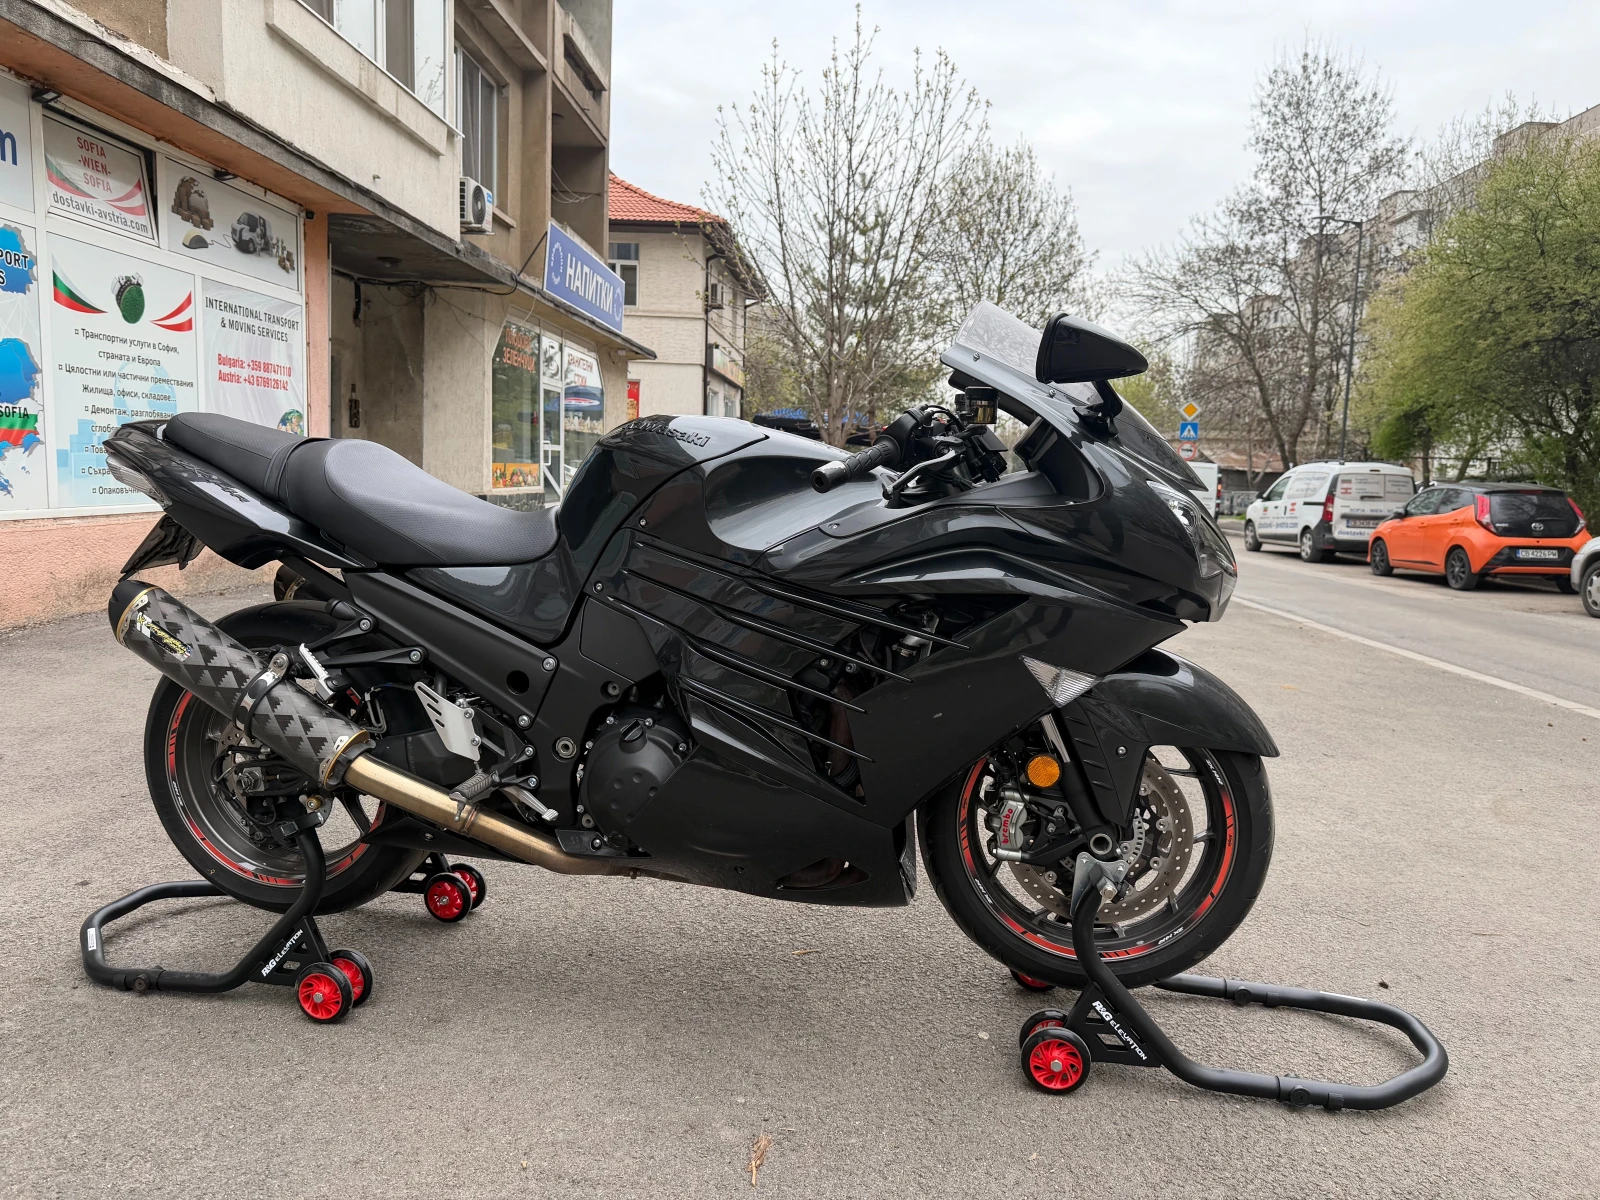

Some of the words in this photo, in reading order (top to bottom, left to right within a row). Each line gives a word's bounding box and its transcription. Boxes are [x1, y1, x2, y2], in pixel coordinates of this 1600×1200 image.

[77, 136, 107, 159] SOFIA
[78, 154, 112, 176] -WIEN-
[82, 172, 113, 194] SOFIA
[52, 190, 149, 234] dostavki-avstria.com
[565, 253, 614, 315] НАПИТКИ
[205, 296, 263, 322] INTERNATIONAL
[263, 312, 300, 331] TRANSPORT
[220, 316, 227, 329] &
[228, 318, 256, 335] MOVING
[257, 325, 289, 343] SERVICES
[81, 328, 128, 345] Транспортни
[128, 339, 152, 350] услуги
[157, 342, 180, 355] София,
[98, 350, 131, 362] страната
[137, 355, 161, 367] Европа
[217, 353, 246, 369] Bulgaria:
[246, 359, 262, 373] +359
[65, 363, 102, 377] Цялостни
[103, 370, 117, 378] или
[117, 372, 150, 383] частични
[150, 376, 194, 388] премествания
[218, 369, 242, 385] Austria:
[243, 374, 255, 387] +43
[82, 383, 116, 397] Жилища,
[116, 388, 140, 400] офиси,
[141, 391, 177, 402] складове...
[90, 404, 130, 417] Демонтаж,
[1001, 807, 1014, 844] brembo
[1091, 1000, 1113, 1022] R&G
